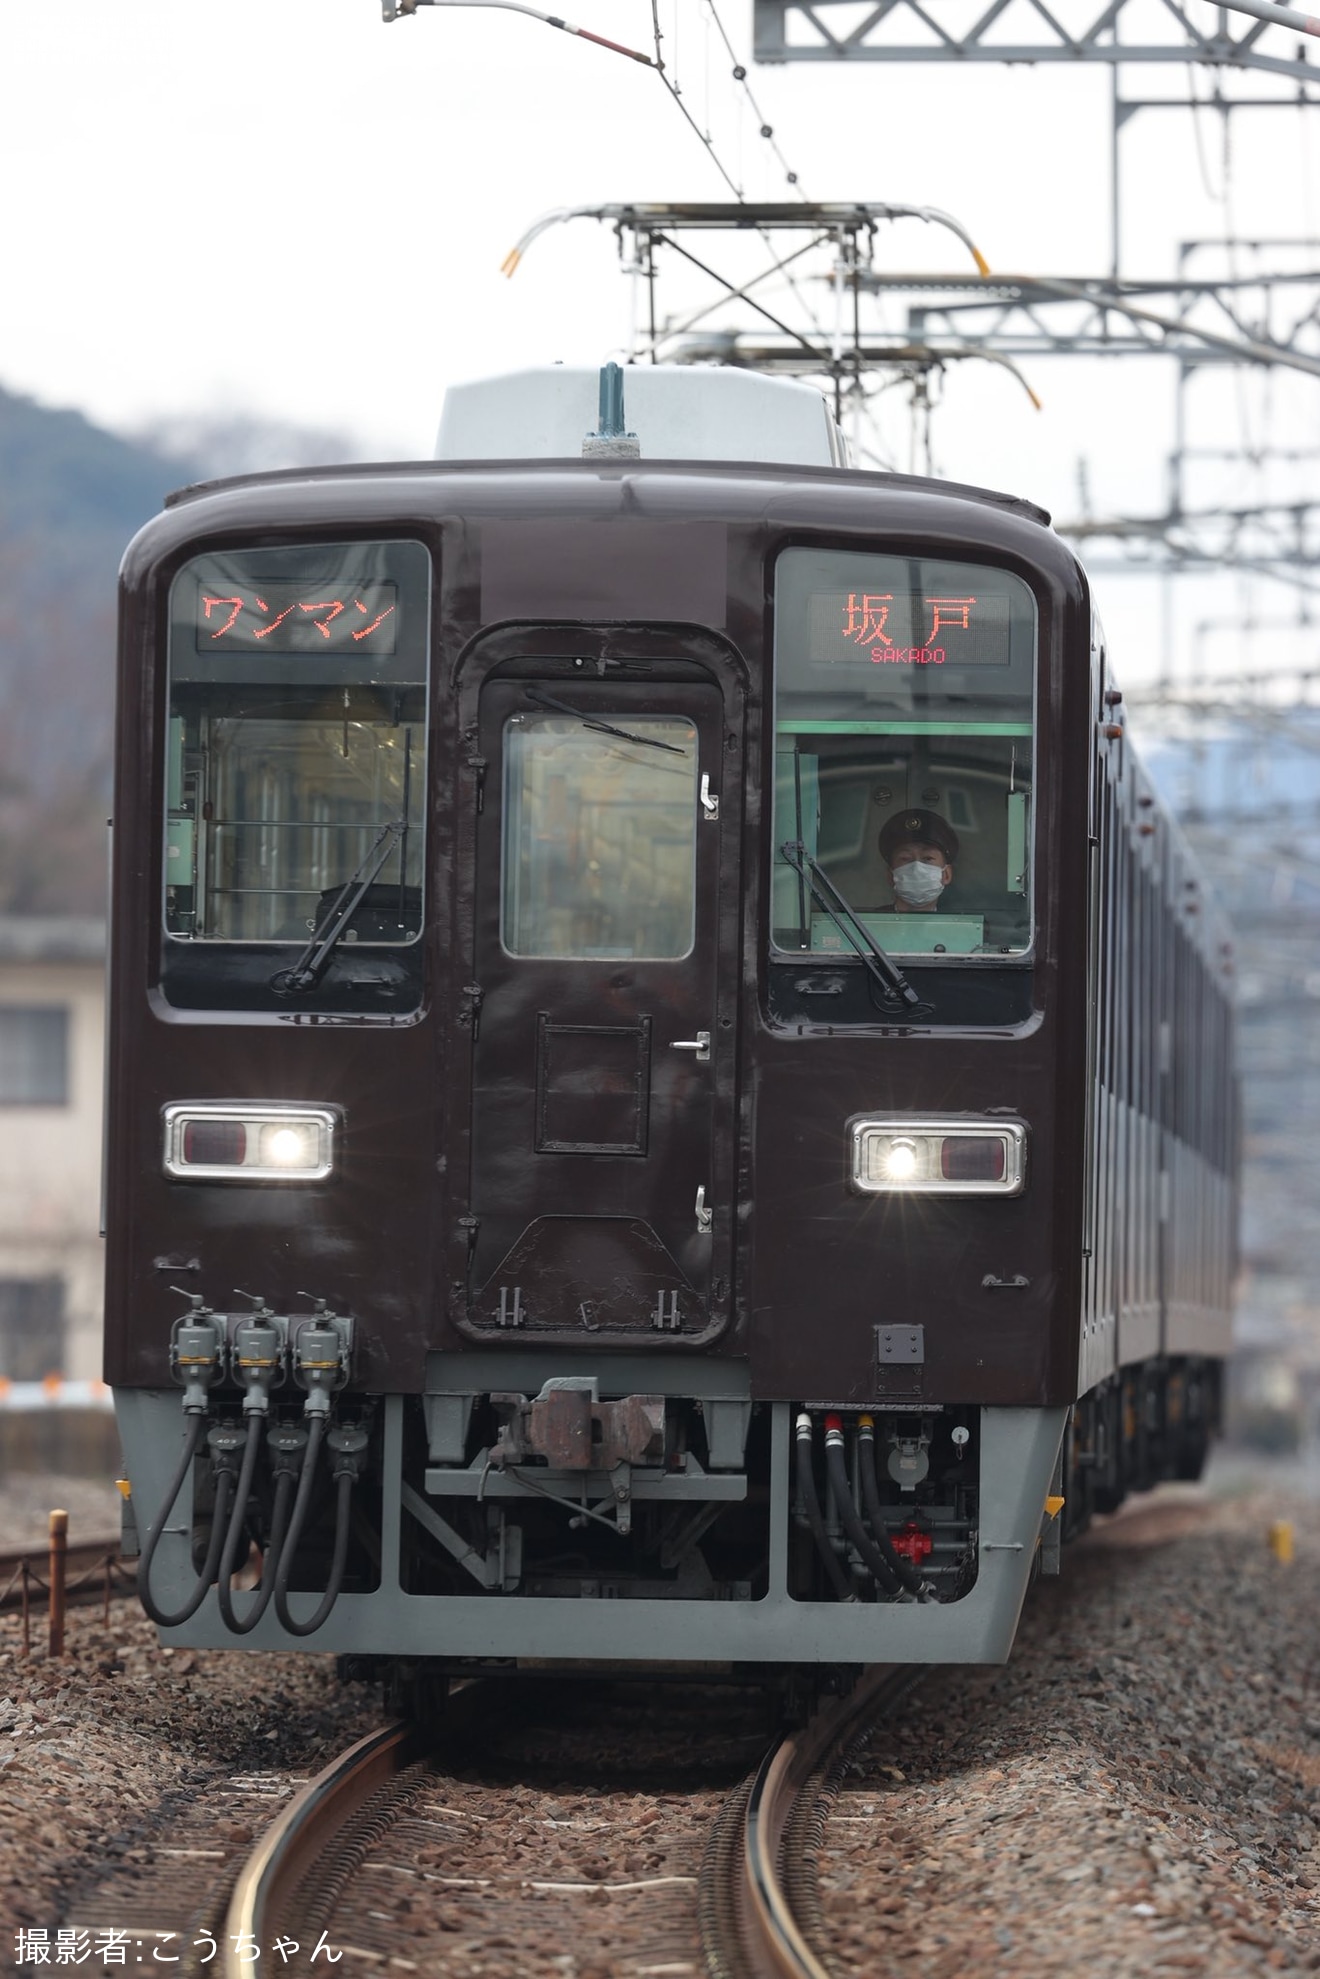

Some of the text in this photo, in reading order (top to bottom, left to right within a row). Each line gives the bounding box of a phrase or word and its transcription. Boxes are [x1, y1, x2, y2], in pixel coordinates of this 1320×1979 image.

[201, 596, 395, 640] ワンマン
[842, 594, 976, 646] 坂戸
[871, 647, 946, 664] SAKADO
